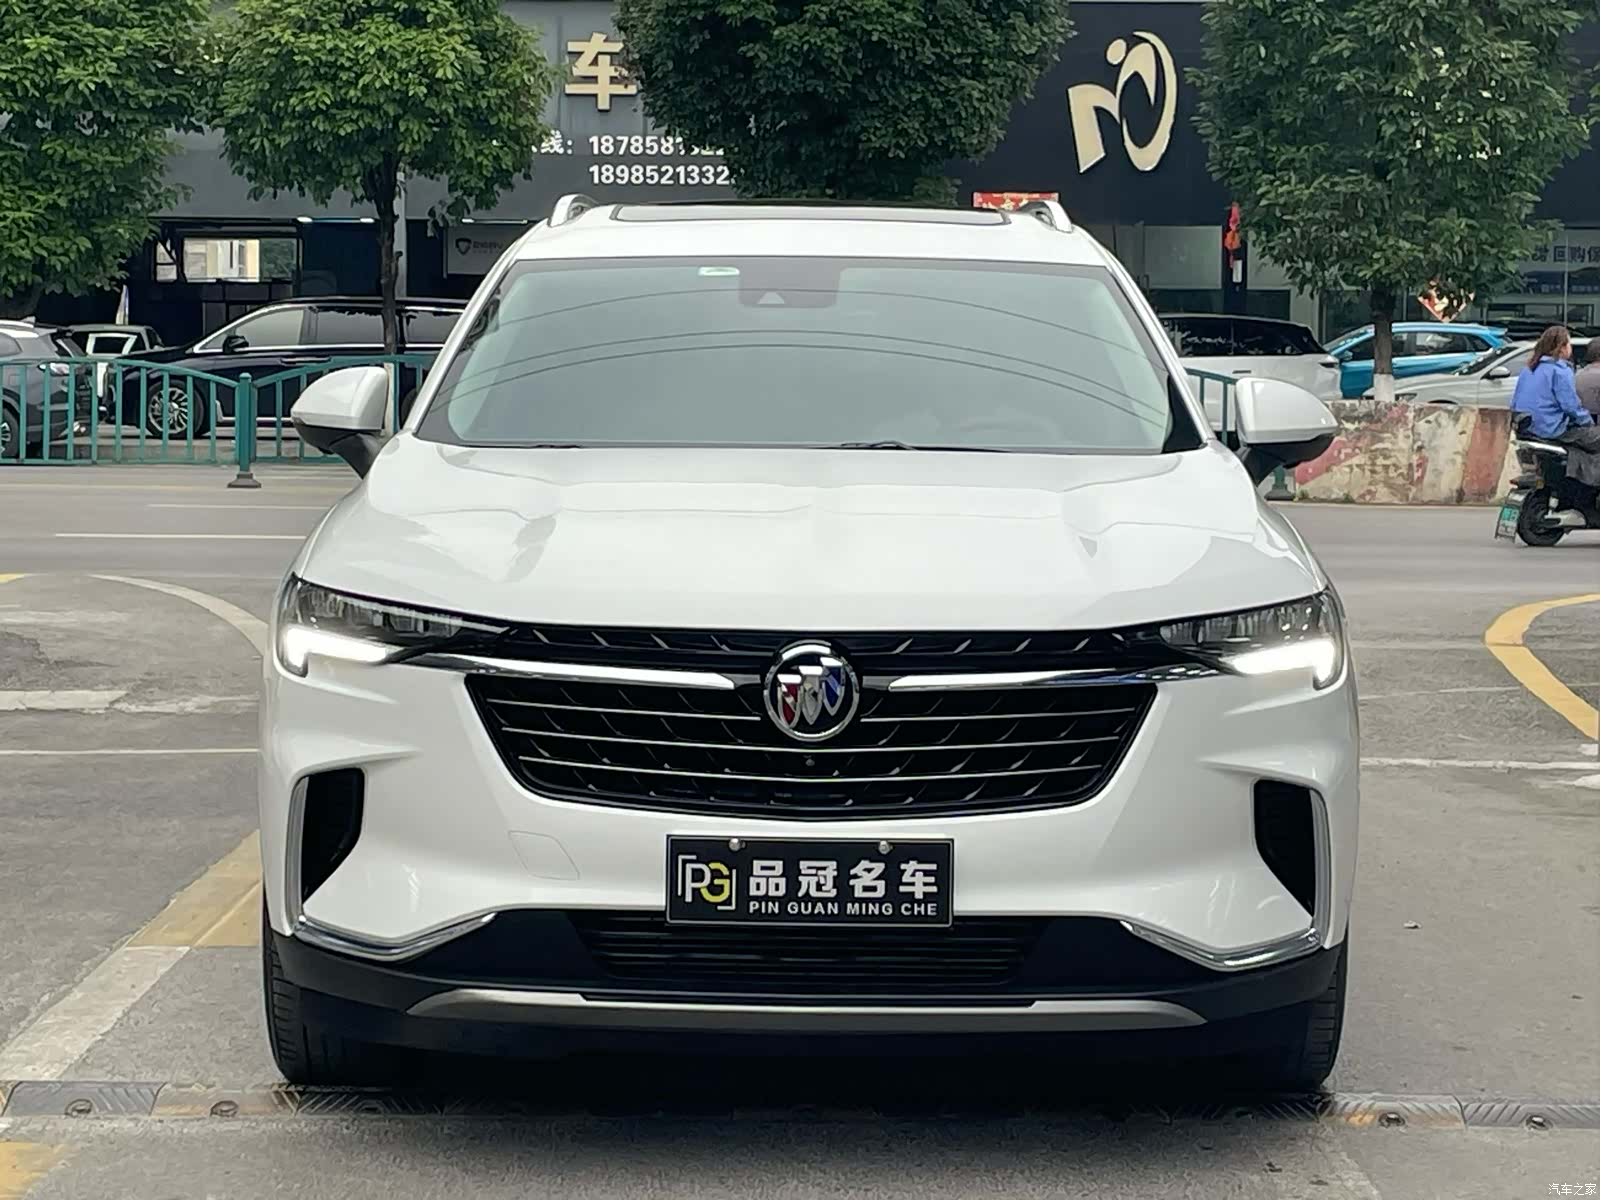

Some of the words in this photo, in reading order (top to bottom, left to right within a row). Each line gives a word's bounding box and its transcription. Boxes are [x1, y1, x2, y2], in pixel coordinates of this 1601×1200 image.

[564, 31, 637, 110] 车
[588, 165, 736, 185] 1898521332
[749, 859, 938, 900] 品冠名车
[749, 901, 780, 915] PIN
[787, 902, 839, 915] GUAN
[846, 903, 893, 916] MING
[900, 903, 938, 916] CHE
